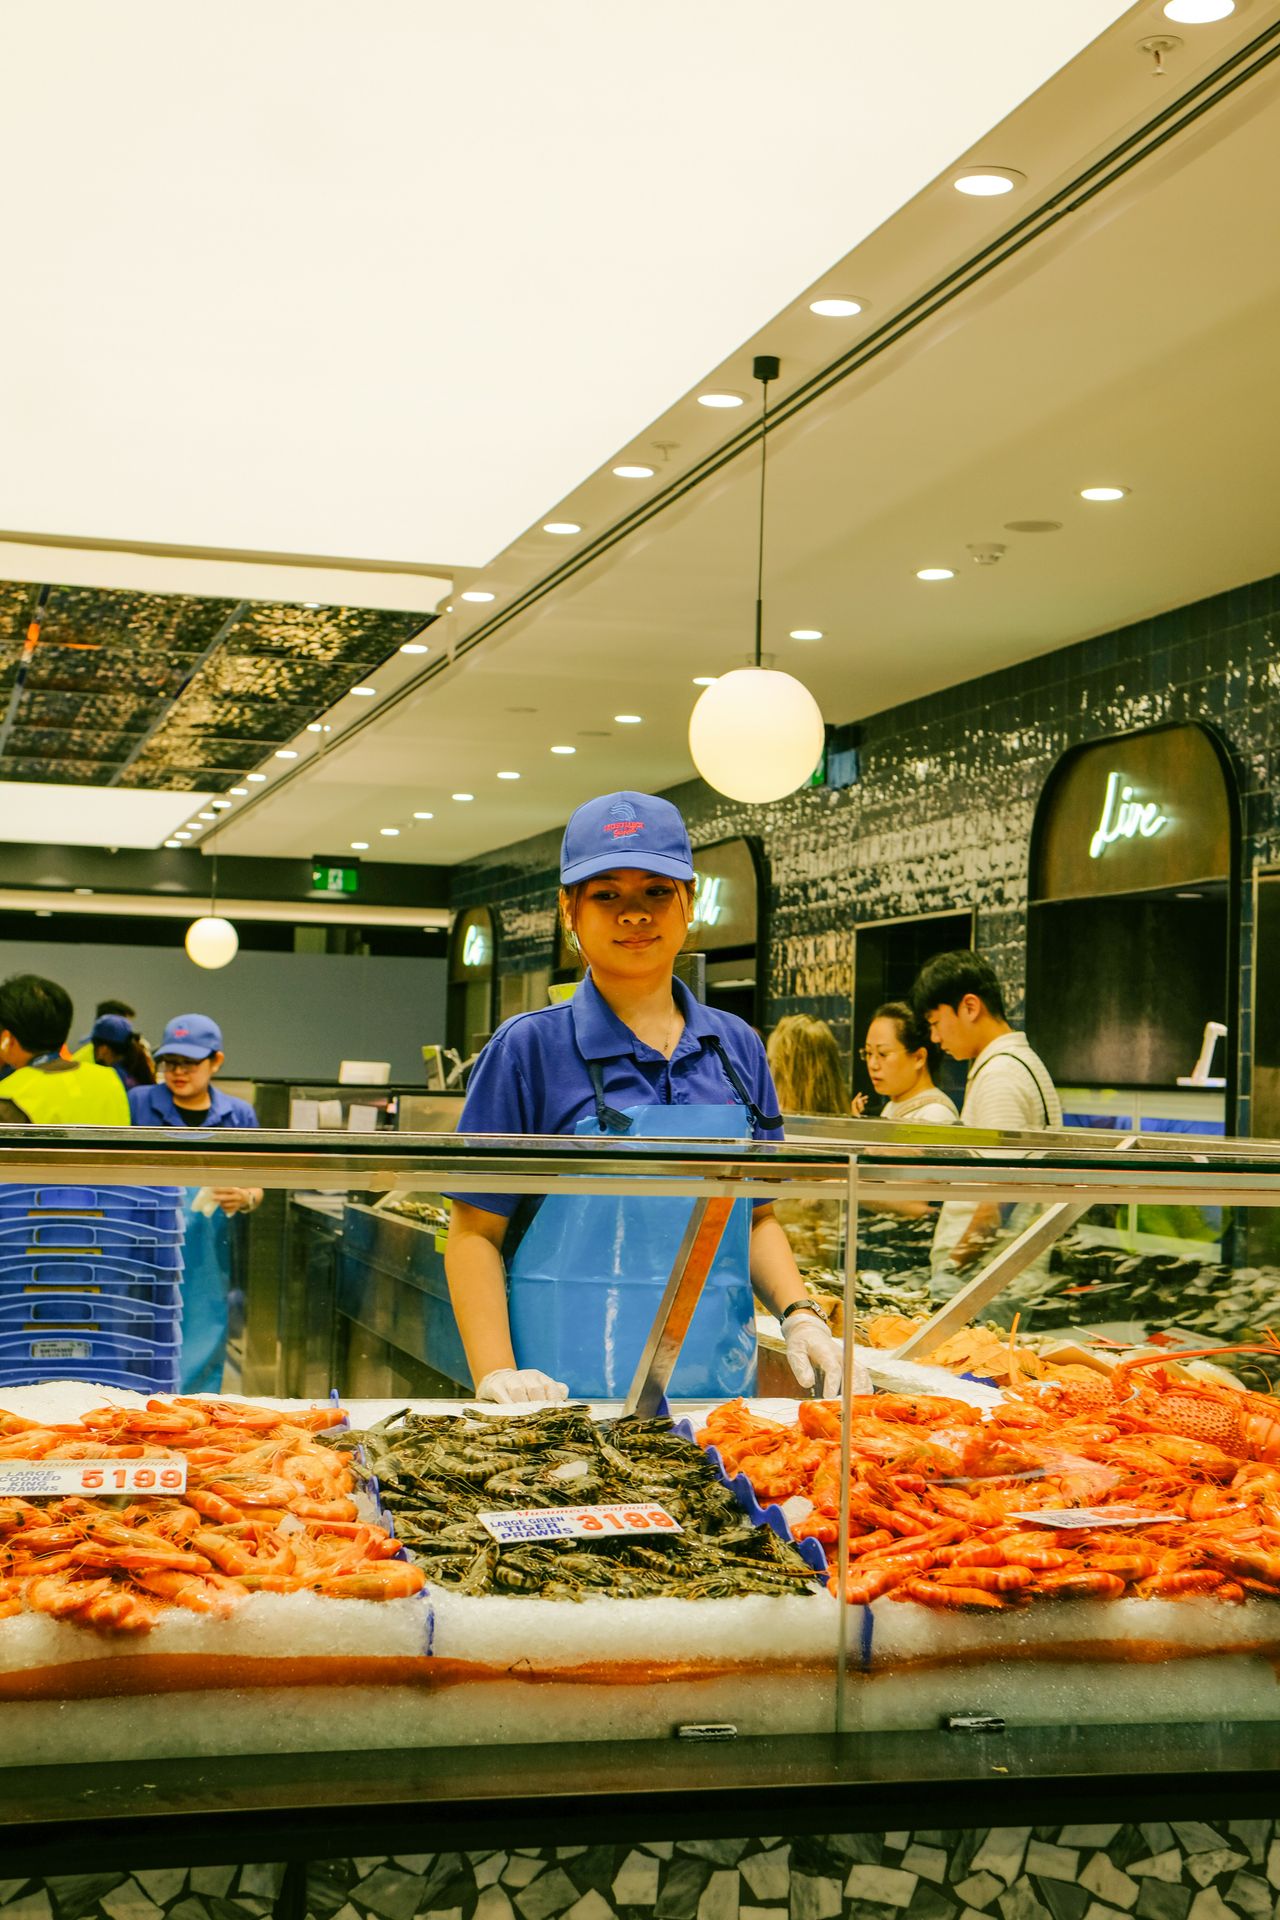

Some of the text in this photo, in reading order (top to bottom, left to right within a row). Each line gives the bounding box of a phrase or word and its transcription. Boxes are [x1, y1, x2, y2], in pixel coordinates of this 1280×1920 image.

[1089, 771, 1167, 858] Live
[490, 1516, 566, 1528] LARGE GREEN
[504, 1522, 559, 1533] TIGER
[501, 1527, 574, 1540] PRAWNS
